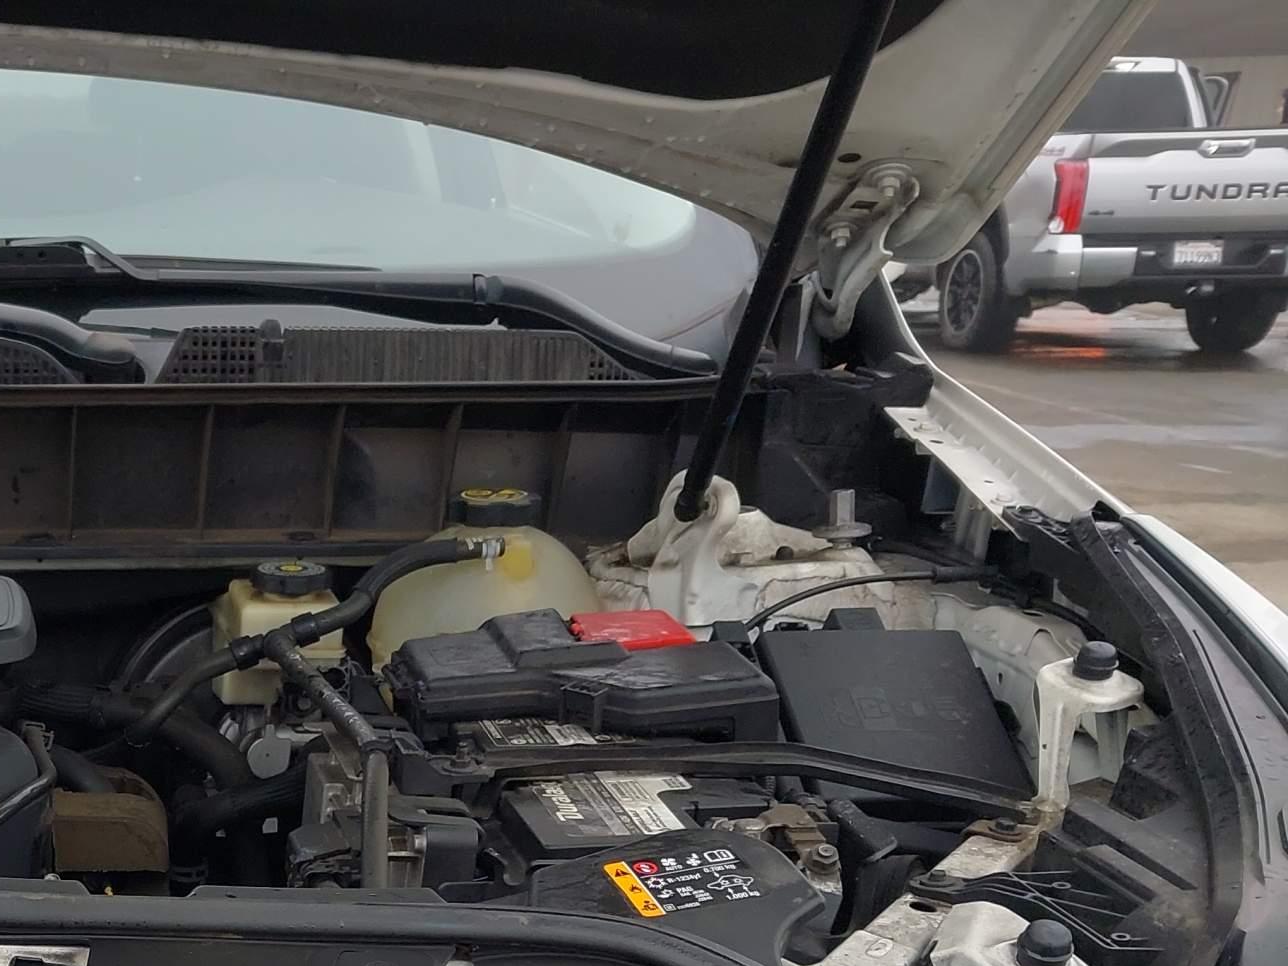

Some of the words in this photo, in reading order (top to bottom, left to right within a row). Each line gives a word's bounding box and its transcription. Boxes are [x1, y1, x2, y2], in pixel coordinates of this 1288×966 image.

[1145, 182, 1288, 201] TUNDRA
[666, 873, 702, 883] R-1234yf
[726, 891, 748, 901] 1.000
[748, 890, 761, 898] kg
